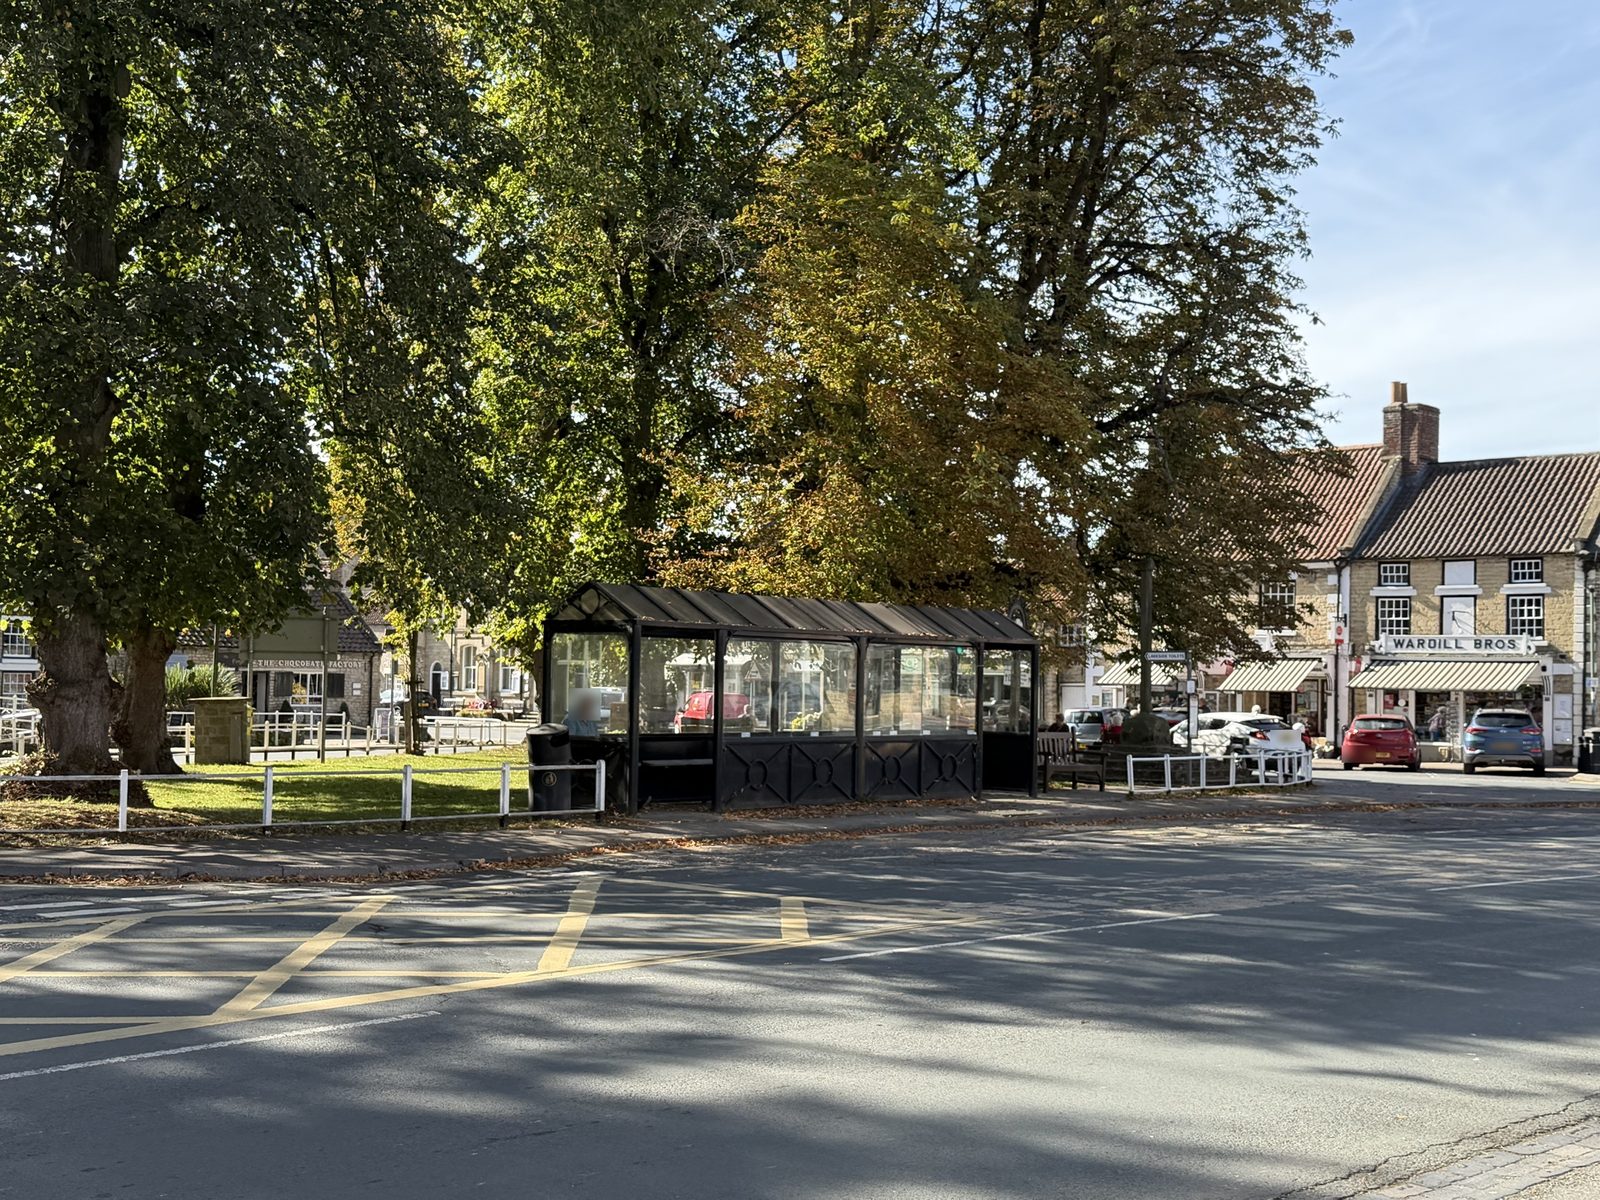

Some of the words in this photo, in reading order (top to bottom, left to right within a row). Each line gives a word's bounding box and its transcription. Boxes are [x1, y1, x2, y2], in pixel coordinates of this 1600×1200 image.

[1393, 638, 1464, 650] WARDILL
[1474, 639, 1517, 650] BROS
[257, 659, 273, 668] THE
[329, 659, 362, 668] FACTORY
